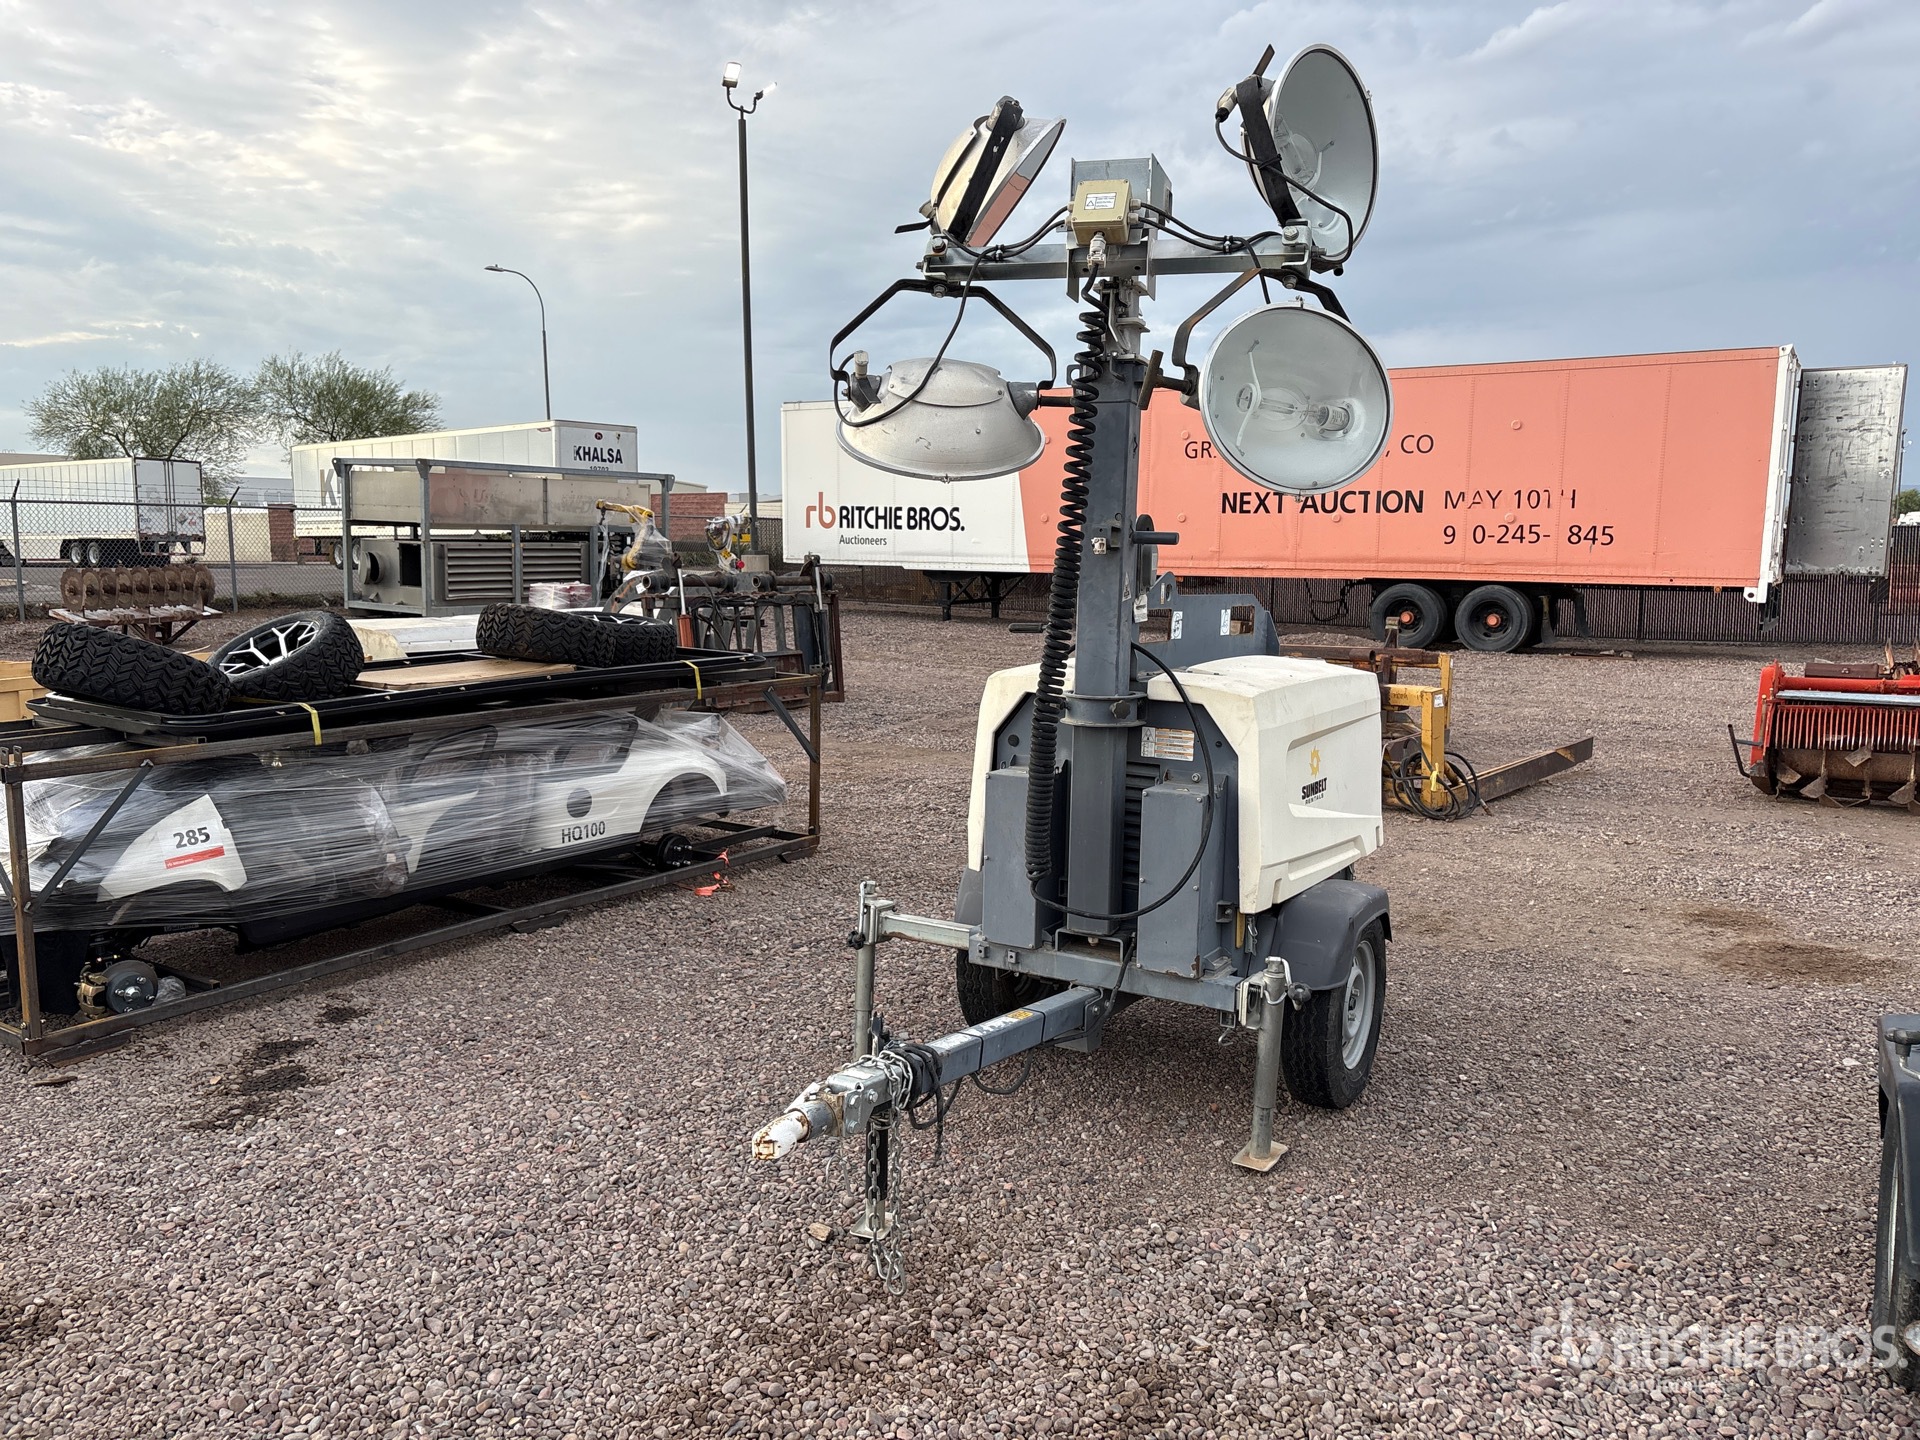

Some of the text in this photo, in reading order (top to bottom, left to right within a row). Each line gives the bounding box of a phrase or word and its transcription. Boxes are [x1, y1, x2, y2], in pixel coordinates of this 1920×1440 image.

[573, 445, 623, 464] KHALSA
[1400, 434, 1434, 454] CO
[1221, 491, 1285, 514] NEXT
[1299, 489, 1424, 514] AUCTION
[1444, 489, 1503, 510] MAY
[839, 505, 903, 530] RITCHIE
[906, 506, 965, 532] BROS.
[839, 534, 887, 546] Auctioneers
[1301, 777, 1327, 800] SUNBELT
[173, 826, 211, 849] 285
[561, 821, 606, 844] HQ100
